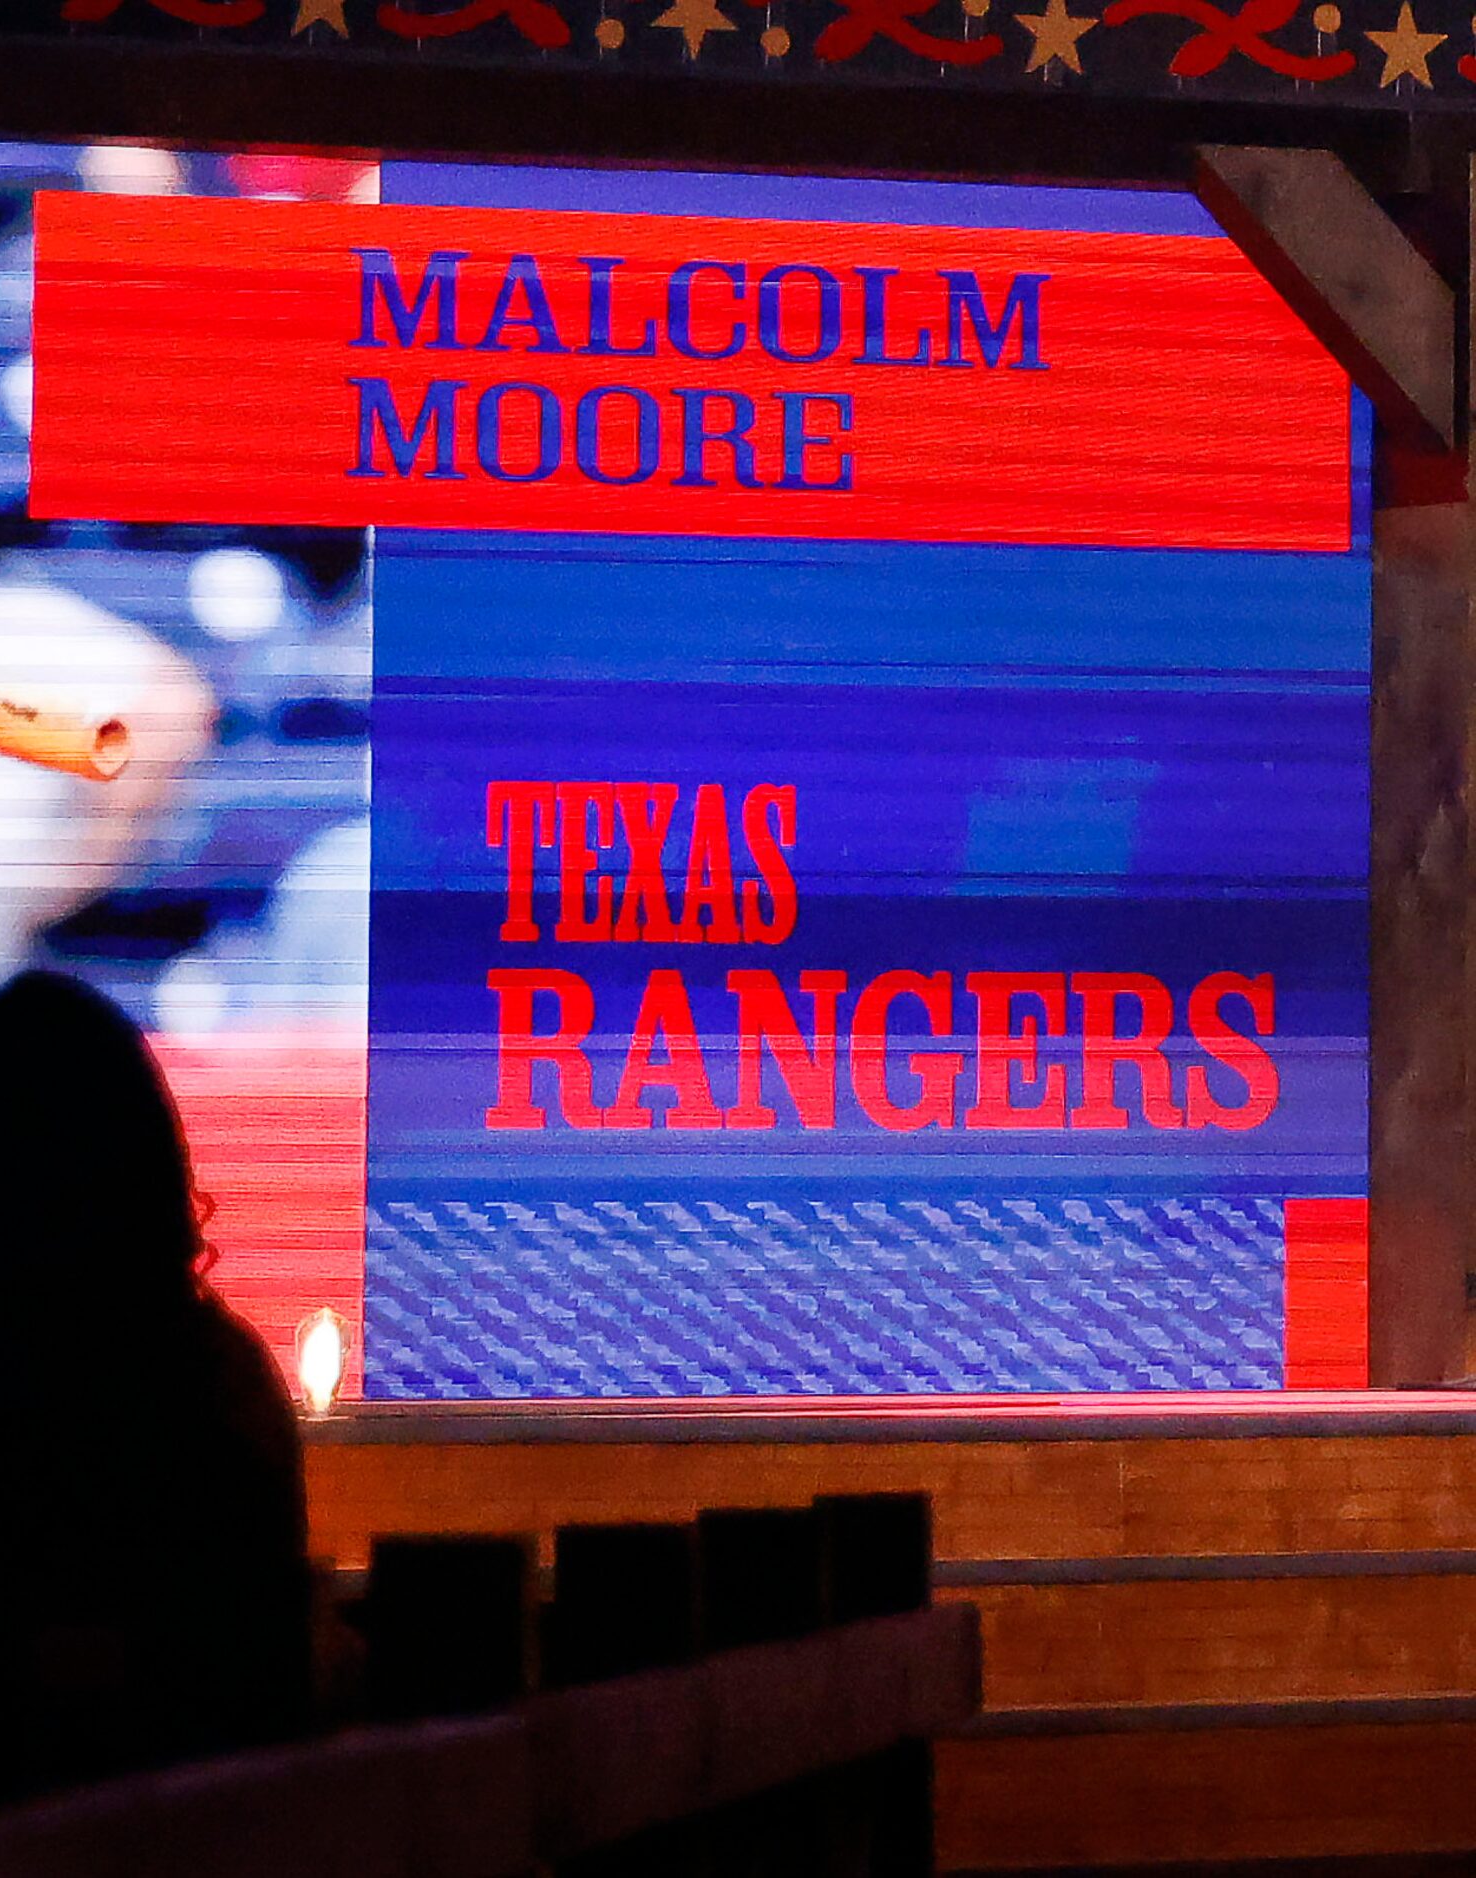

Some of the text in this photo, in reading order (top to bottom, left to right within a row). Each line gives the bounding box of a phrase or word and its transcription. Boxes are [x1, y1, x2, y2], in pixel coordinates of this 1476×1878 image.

[349, 247, 1052, 370] MALCOLM
[346, 377, 855, 491] MOORE
[486, 780, 798, 945] TEXAS
[485, 968, 1280, 1131] RANGERS
